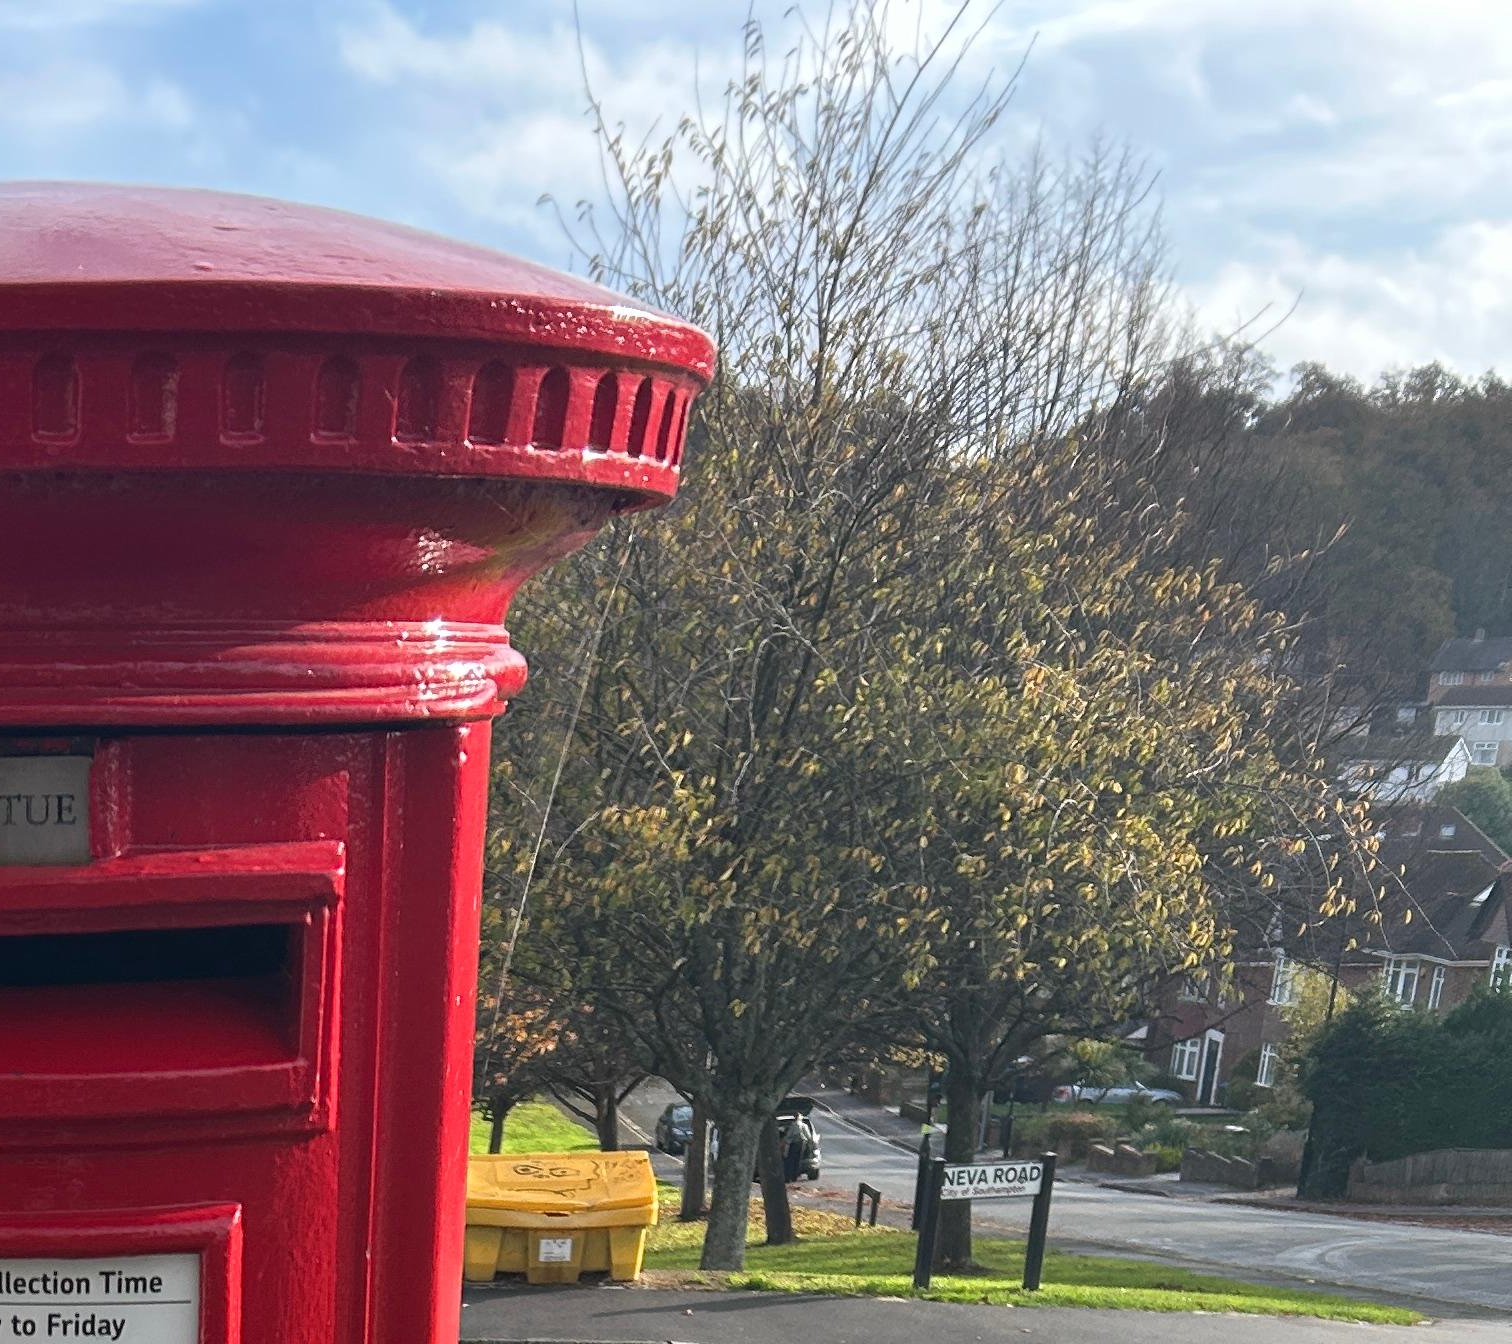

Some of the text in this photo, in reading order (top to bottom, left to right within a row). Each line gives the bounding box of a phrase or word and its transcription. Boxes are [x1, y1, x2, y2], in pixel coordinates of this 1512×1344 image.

[944, 1165, 1041, 1187] NEVA ROAD
[98, 1269, 163, 1294] Time
[10, 1315, 36, 1337] to
[47, 1312, 126, 1342] Friday
